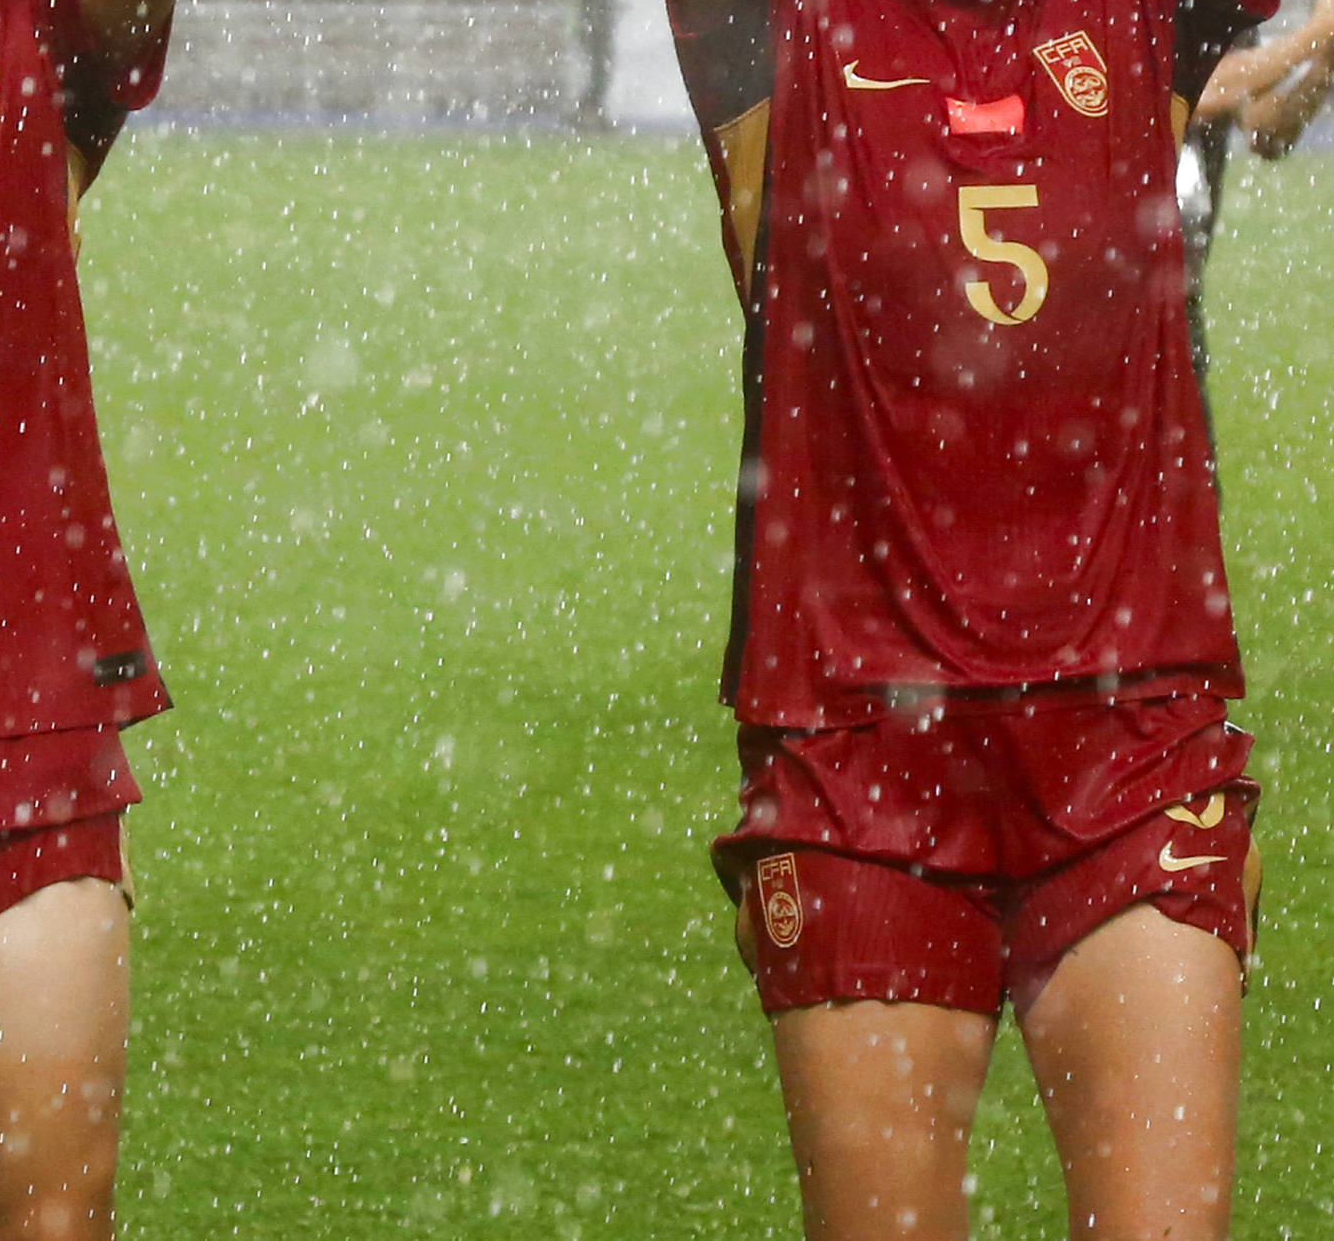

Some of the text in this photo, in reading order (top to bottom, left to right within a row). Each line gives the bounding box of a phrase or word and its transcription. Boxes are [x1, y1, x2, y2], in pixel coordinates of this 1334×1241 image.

[1042, 38, 1089, 63] CFA
[958, 184, 1049, 326] 5
[762, 860, 792, 880] CFA
